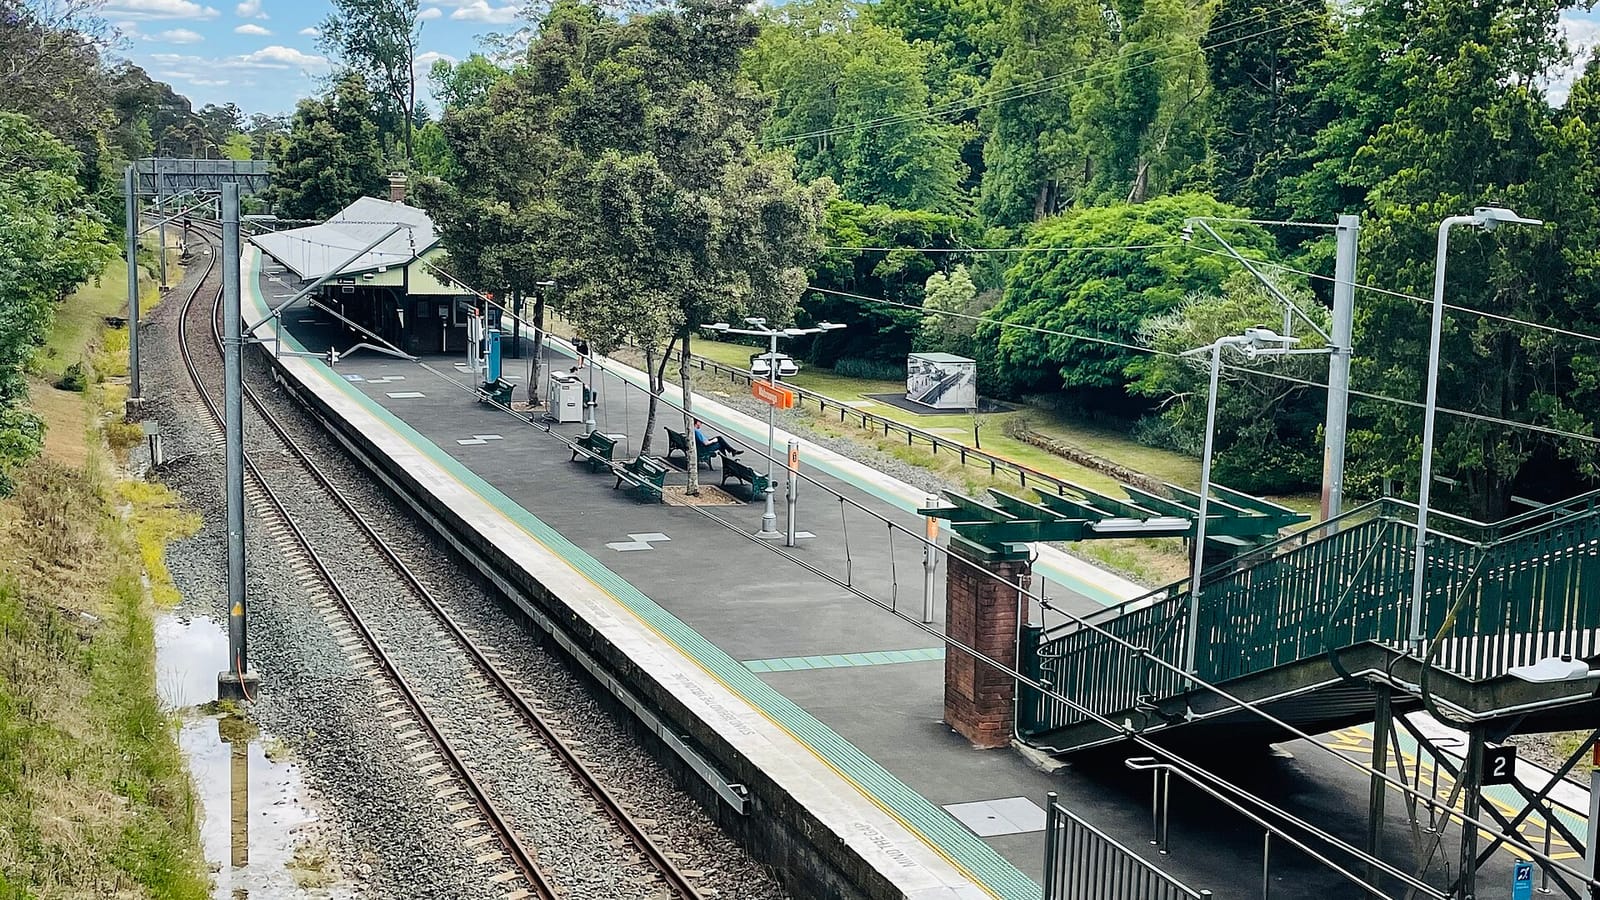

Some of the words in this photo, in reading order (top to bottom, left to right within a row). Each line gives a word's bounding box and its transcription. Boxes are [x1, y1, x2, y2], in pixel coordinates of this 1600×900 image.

[1494, 756, 1506, 777] 2
[854, 823, 878, 836] GAP
[869, 836, 894, 850] THE
[886, 849, 918, 868] MIND
